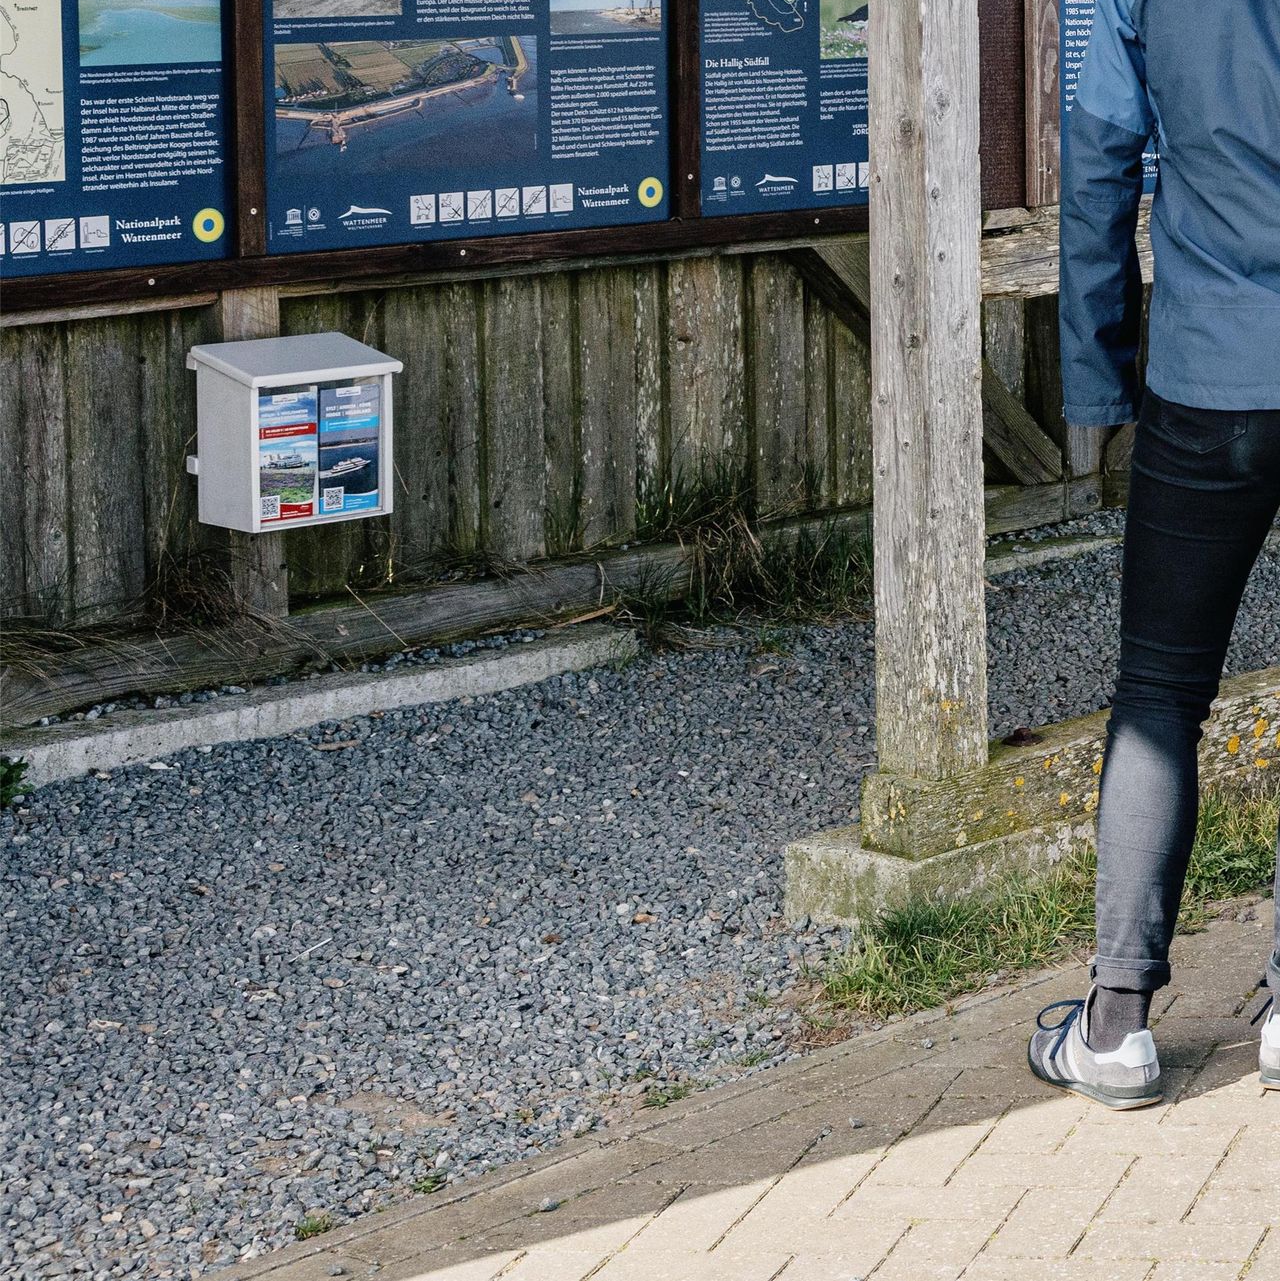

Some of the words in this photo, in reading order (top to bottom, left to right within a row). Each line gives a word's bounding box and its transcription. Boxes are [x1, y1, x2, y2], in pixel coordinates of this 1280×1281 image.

[705, 58, 719, 68] Die
[720, 58, 743, 69] Hallig
[744, 56, 770, 66] Südfall
[156, 94, 193, 102] Nordstrands
[131, 105, 160, 113] Halbinsel.
[190, 103, 218, 112] dreißiger
[578, 184, 629, 198] Nationalpark
[582, 198, 629, 208] Wattenmeer
[116, 216, 181, 231] Nationalpark
[121, 232, 182, 243] Wattenmeer
